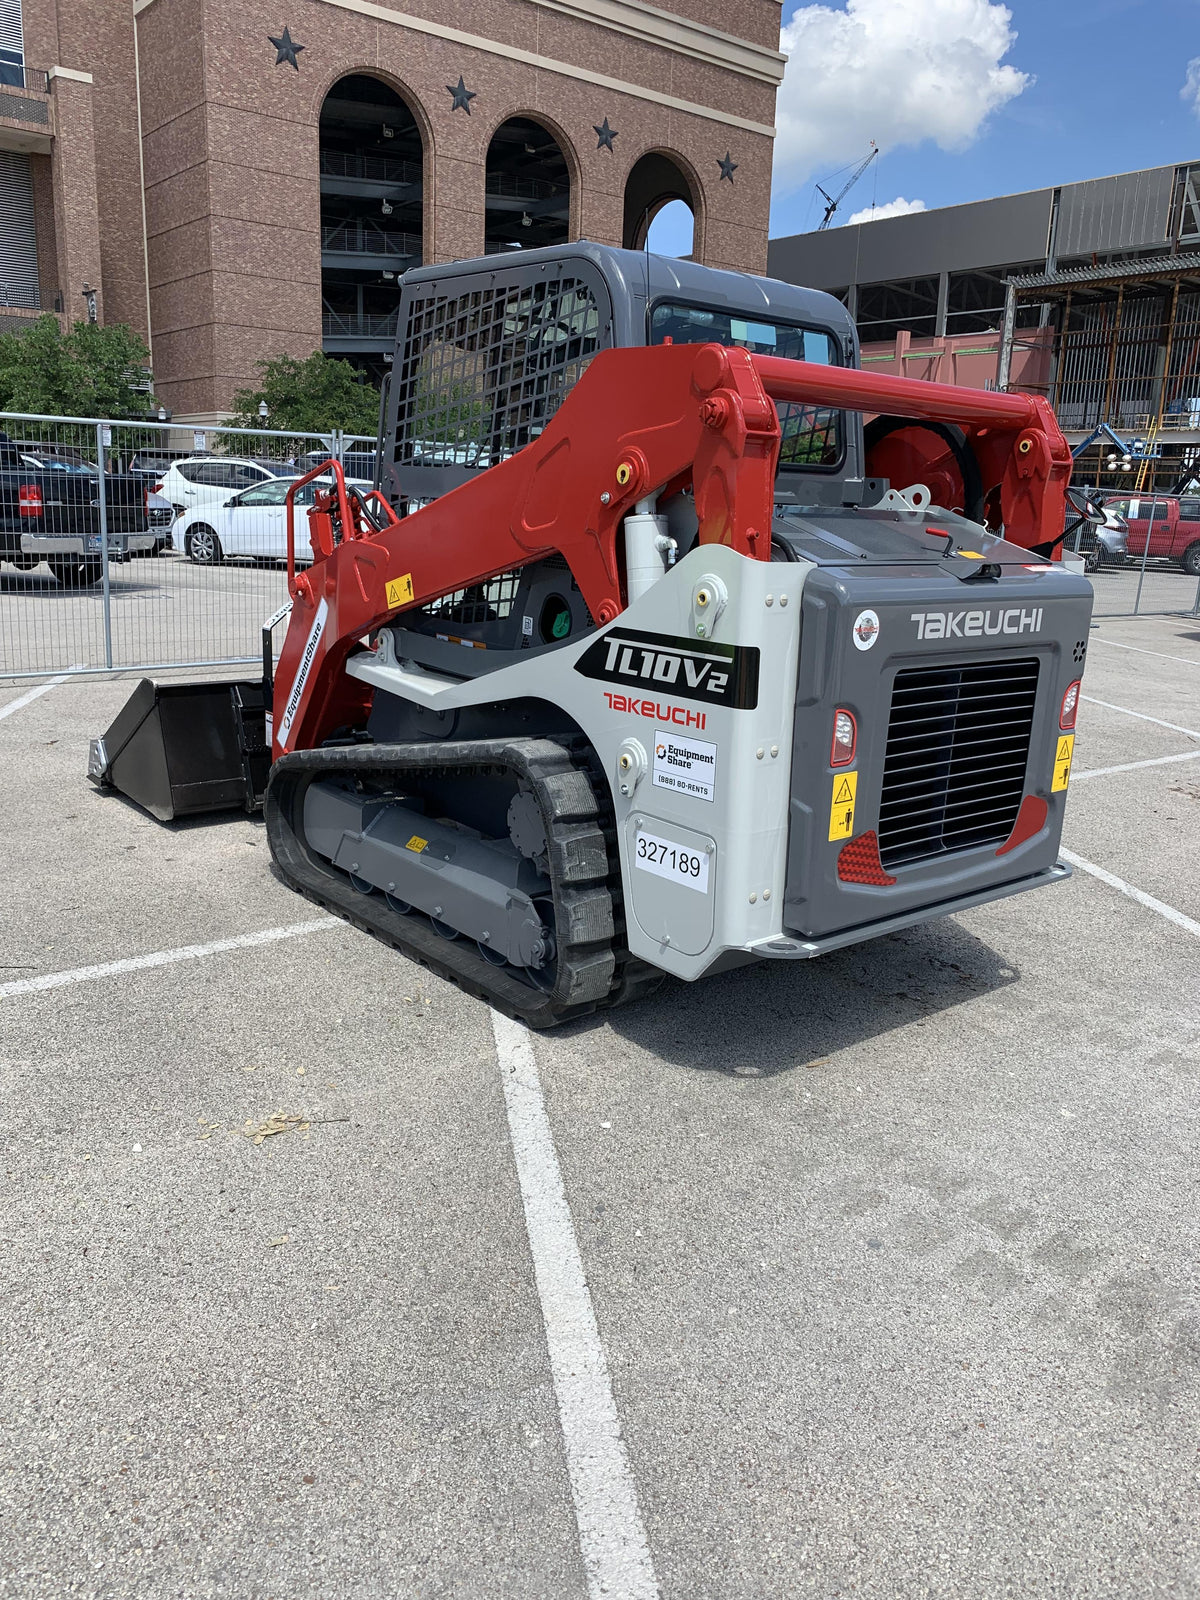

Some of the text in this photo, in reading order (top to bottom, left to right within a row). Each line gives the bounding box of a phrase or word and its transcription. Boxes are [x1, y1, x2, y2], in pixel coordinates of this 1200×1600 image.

[910, 607, 1043, 640] TAKEUCHI
[286, 622, 322, 717] EquipmentShare
[603, 636, 733, 694] TL10V2
[603, 692, 706, 731] TAKEUCHI
[667, 755, 692, 769] Share
[668, 744, 714, 765] Equipment
[658, 774, 676, 787] (888)
[637, 838, 701, 878] 327189
